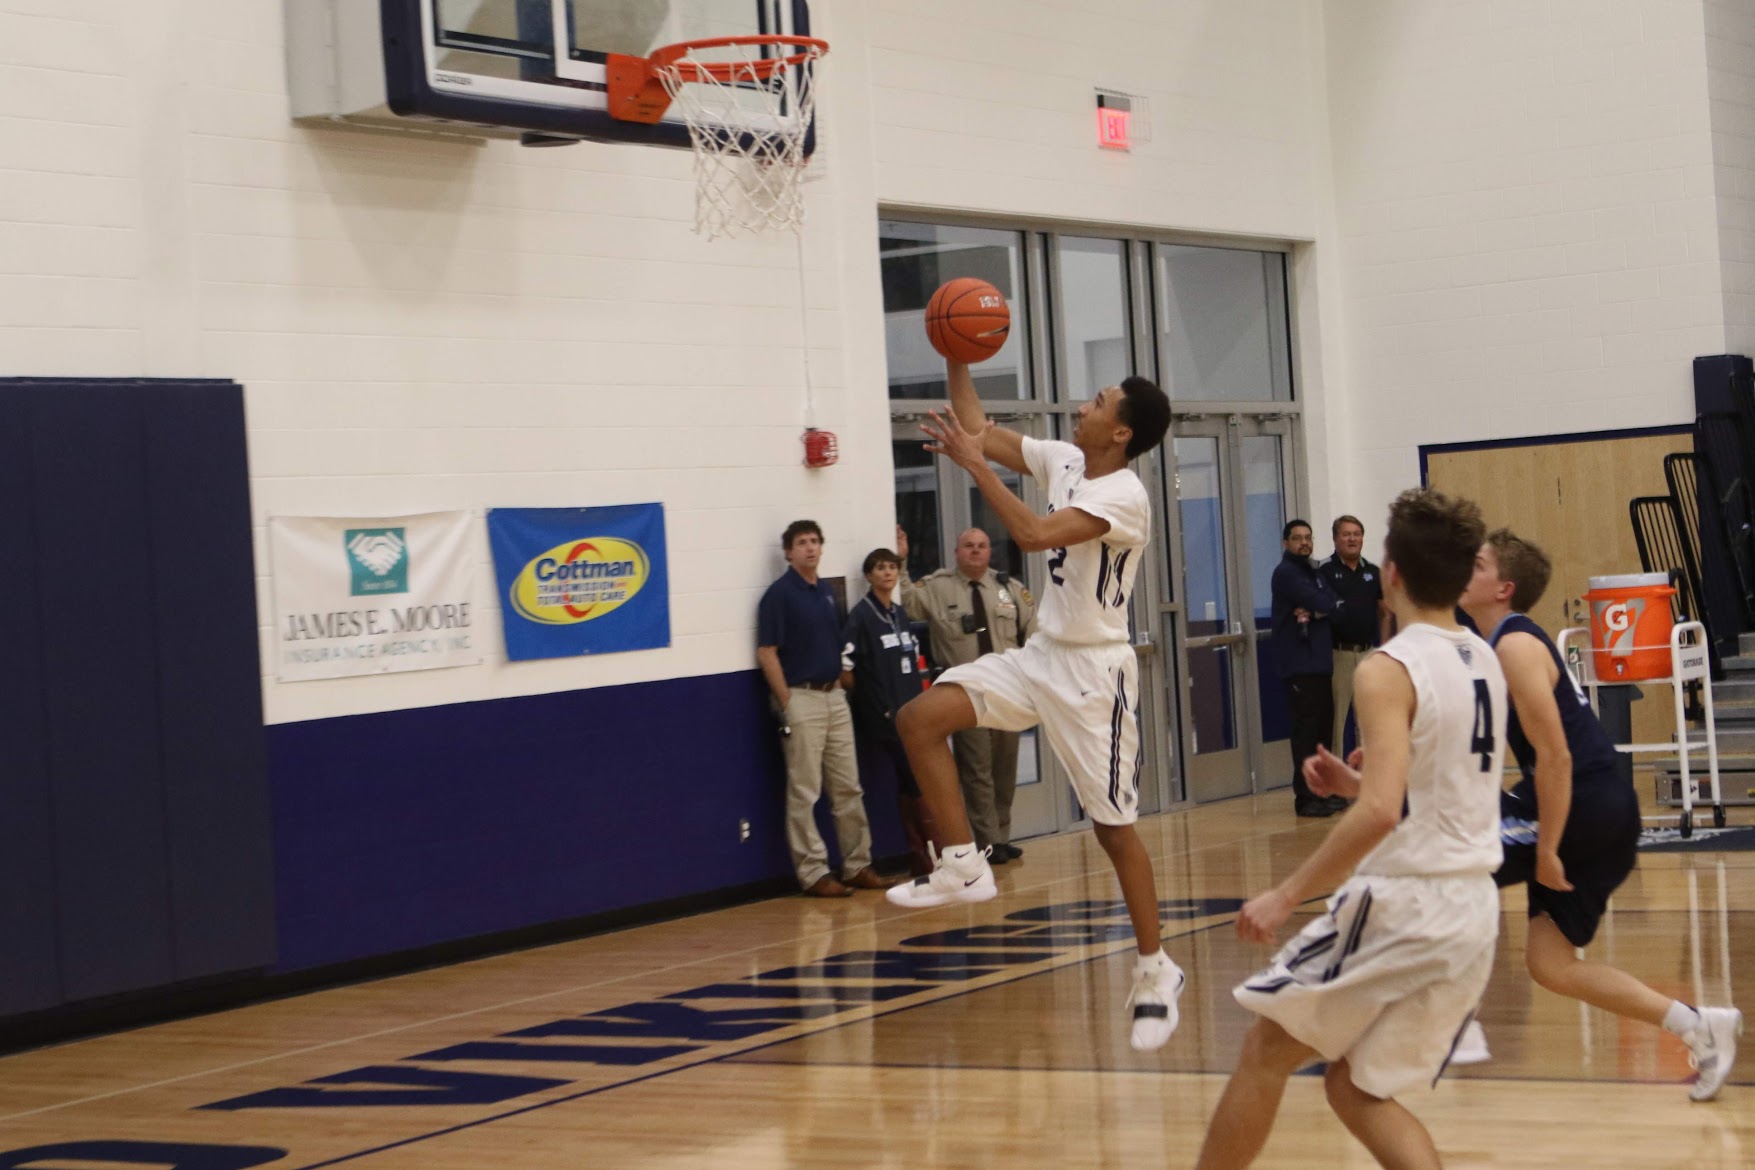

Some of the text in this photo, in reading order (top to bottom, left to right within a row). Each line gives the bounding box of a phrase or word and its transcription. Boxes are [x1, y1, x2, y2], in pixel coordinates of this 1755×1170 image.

[536, 558, 634, 582] Cottman
[601, 590, 626, 601] CARE
[284, 611, 363, 641] JAMES
[390, 602, 471, 634] MOORE
[1605, 603, 1629, 631] G
[285, 643, 375, 664] INSURANCE
[1470, 678, 1495, 773] 4
[188, 897, 1249, 1111] VIKINGS
